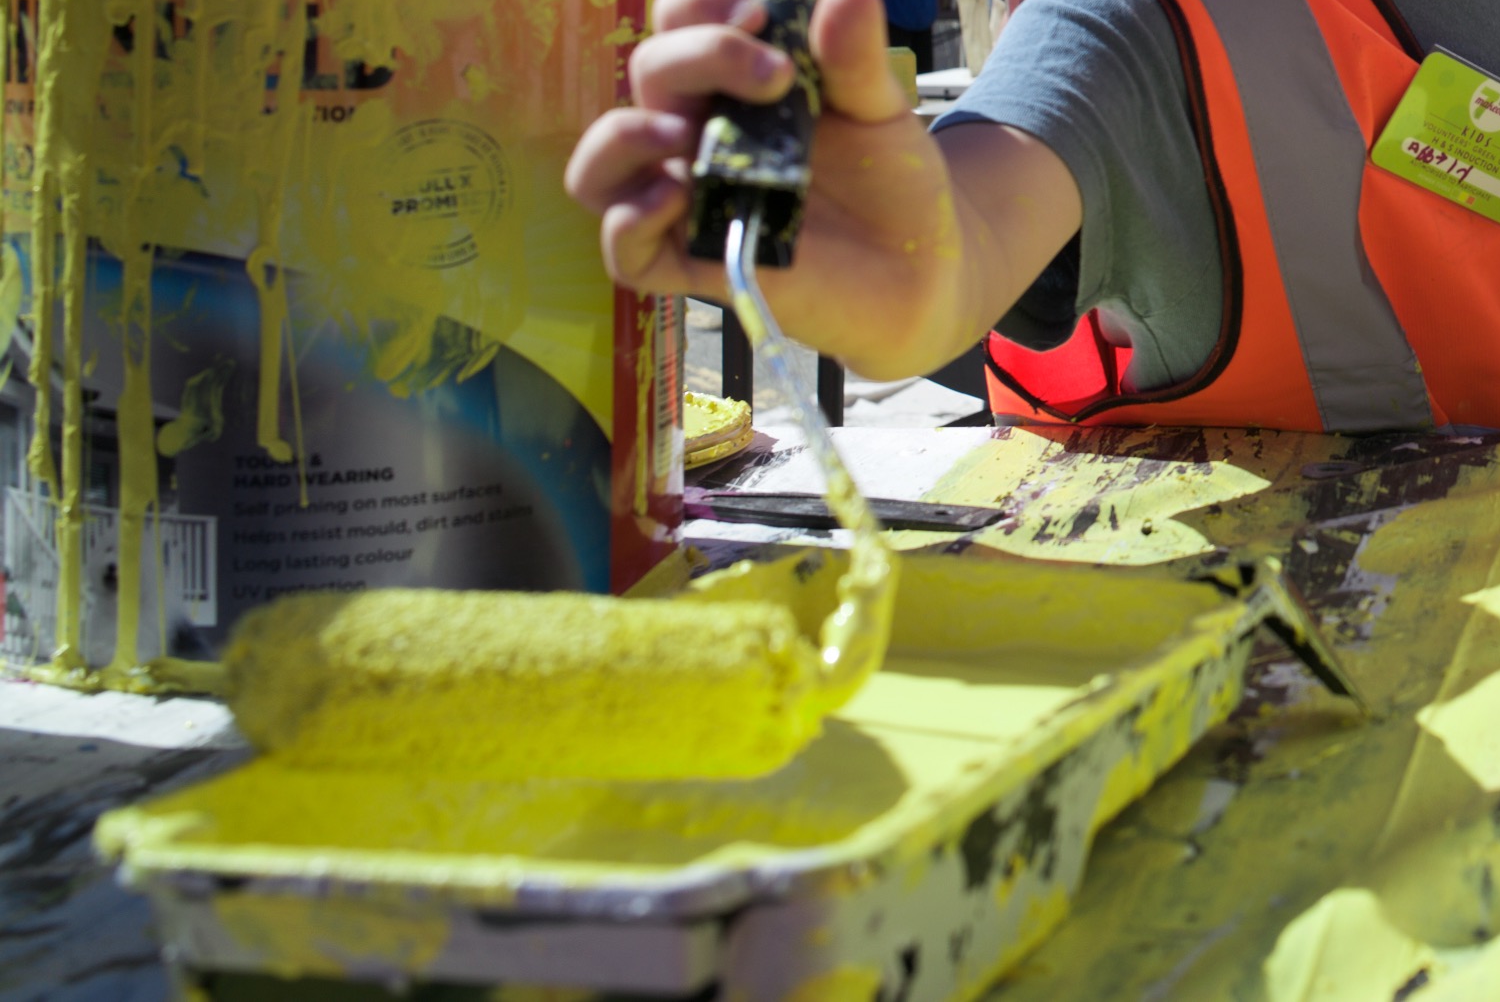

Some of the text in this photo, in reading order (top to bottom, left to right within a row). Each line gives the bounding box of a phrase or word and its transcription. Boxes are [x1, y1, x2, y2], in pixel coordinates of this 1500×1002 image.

[1461, 126, 1492, 147] KIDS
[1447, 144, 1453, 152] S
[1454, 148, 1499, 174] INDUCTION
[1471, 145, 1496, 161] GREEN
[309, 454, 323, 467] &
[234, 466, 394, 489] HARD WEARING
[234, 501, 269, 517] Self
[352, 498, 377, 512] on
[381, 491, 427, 508] most
[431, 483, 503, 504] surfaces
[234, 503, 533, 547] Helps resist mould, dirt and stains
[233, 548, 414, 574] Long lasting colour
[232, 584, 262, 600] UV
